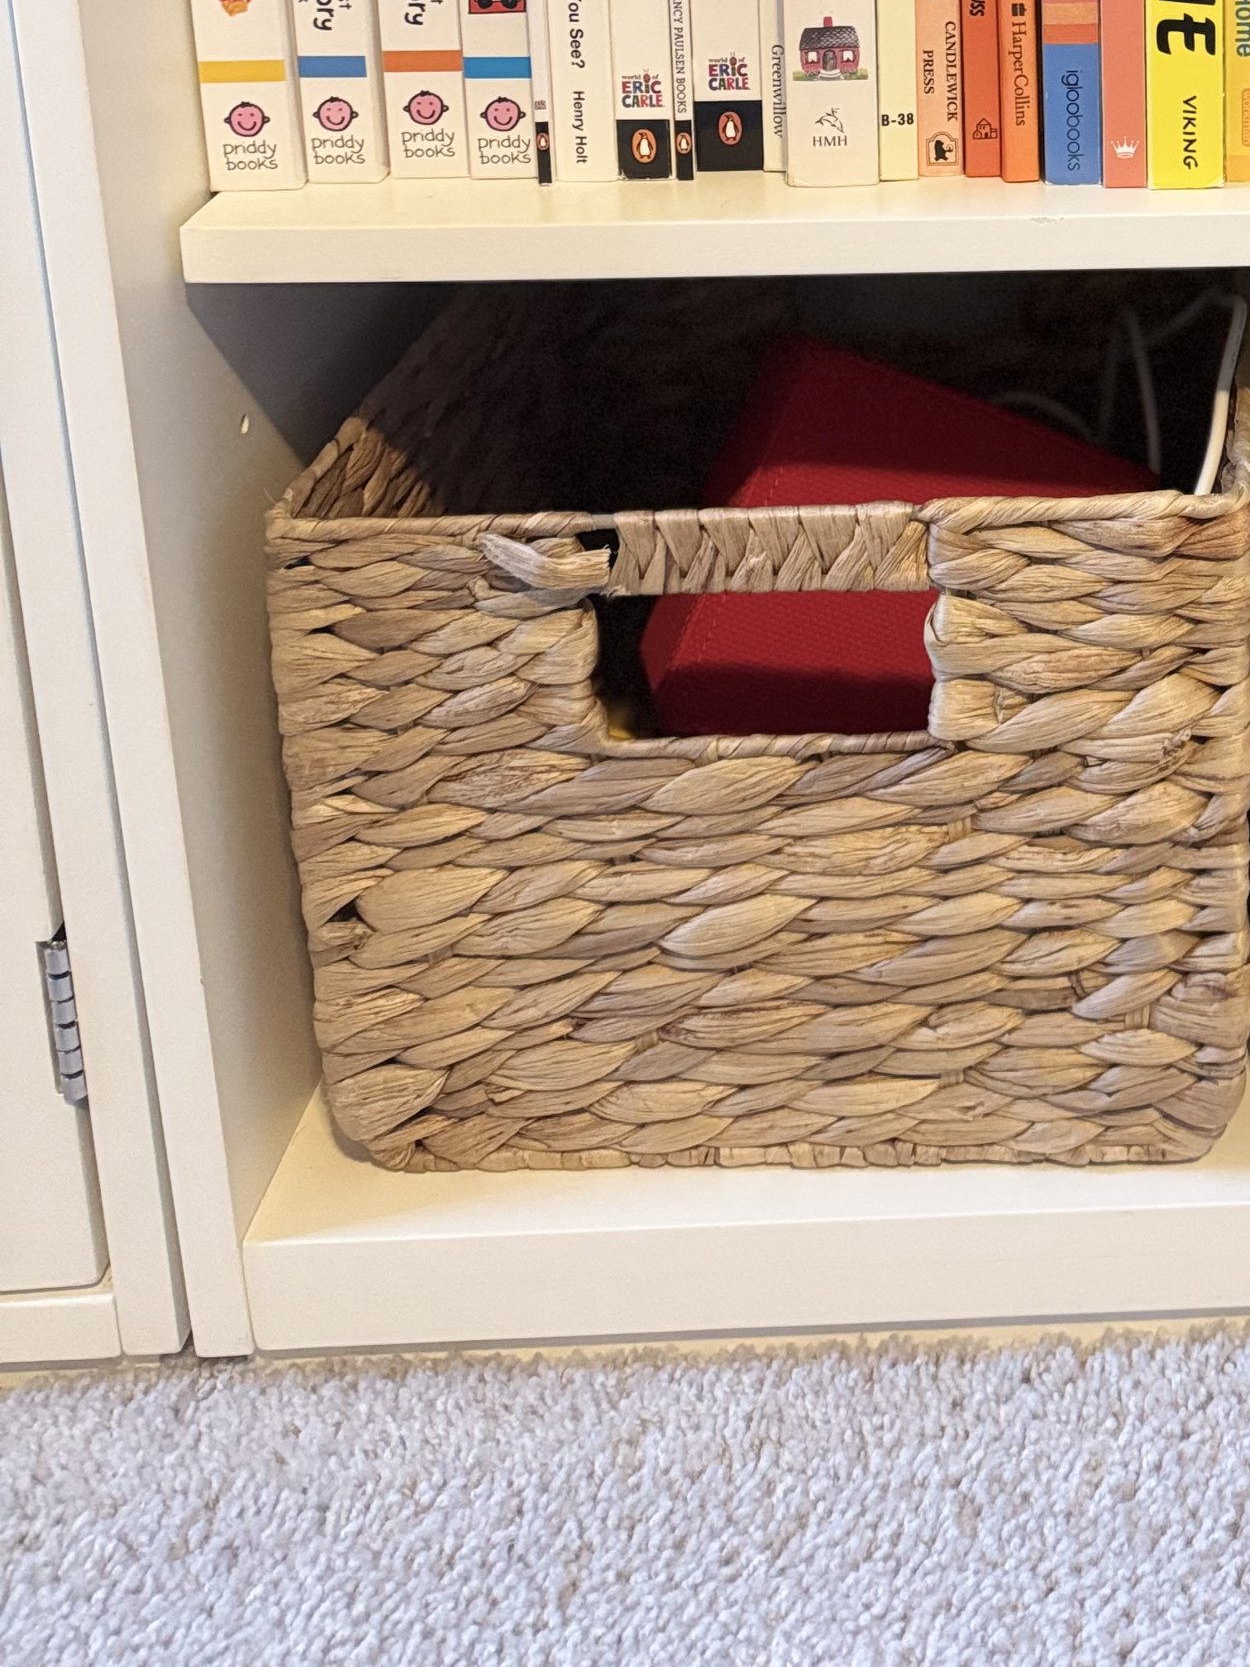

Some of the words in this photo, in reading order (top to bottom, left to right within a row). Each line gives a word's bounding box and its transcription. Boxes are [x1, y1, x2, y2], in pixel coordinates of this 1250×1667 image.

[569, 28, 585, 68] See?
[622, 81, 662, 94] ERIC
[771, 45, 786, 137] Greenwillow
[923, 50, 934, 94] PRESS
[945, 21, 958, 122] CANDLEWICK
[572, 91, 586, 131] Henry
[622, 94, 664, 108] CARLE
[575, 136, 588, 164] Holt
[1182, 96, 1197, 169] VIKING
